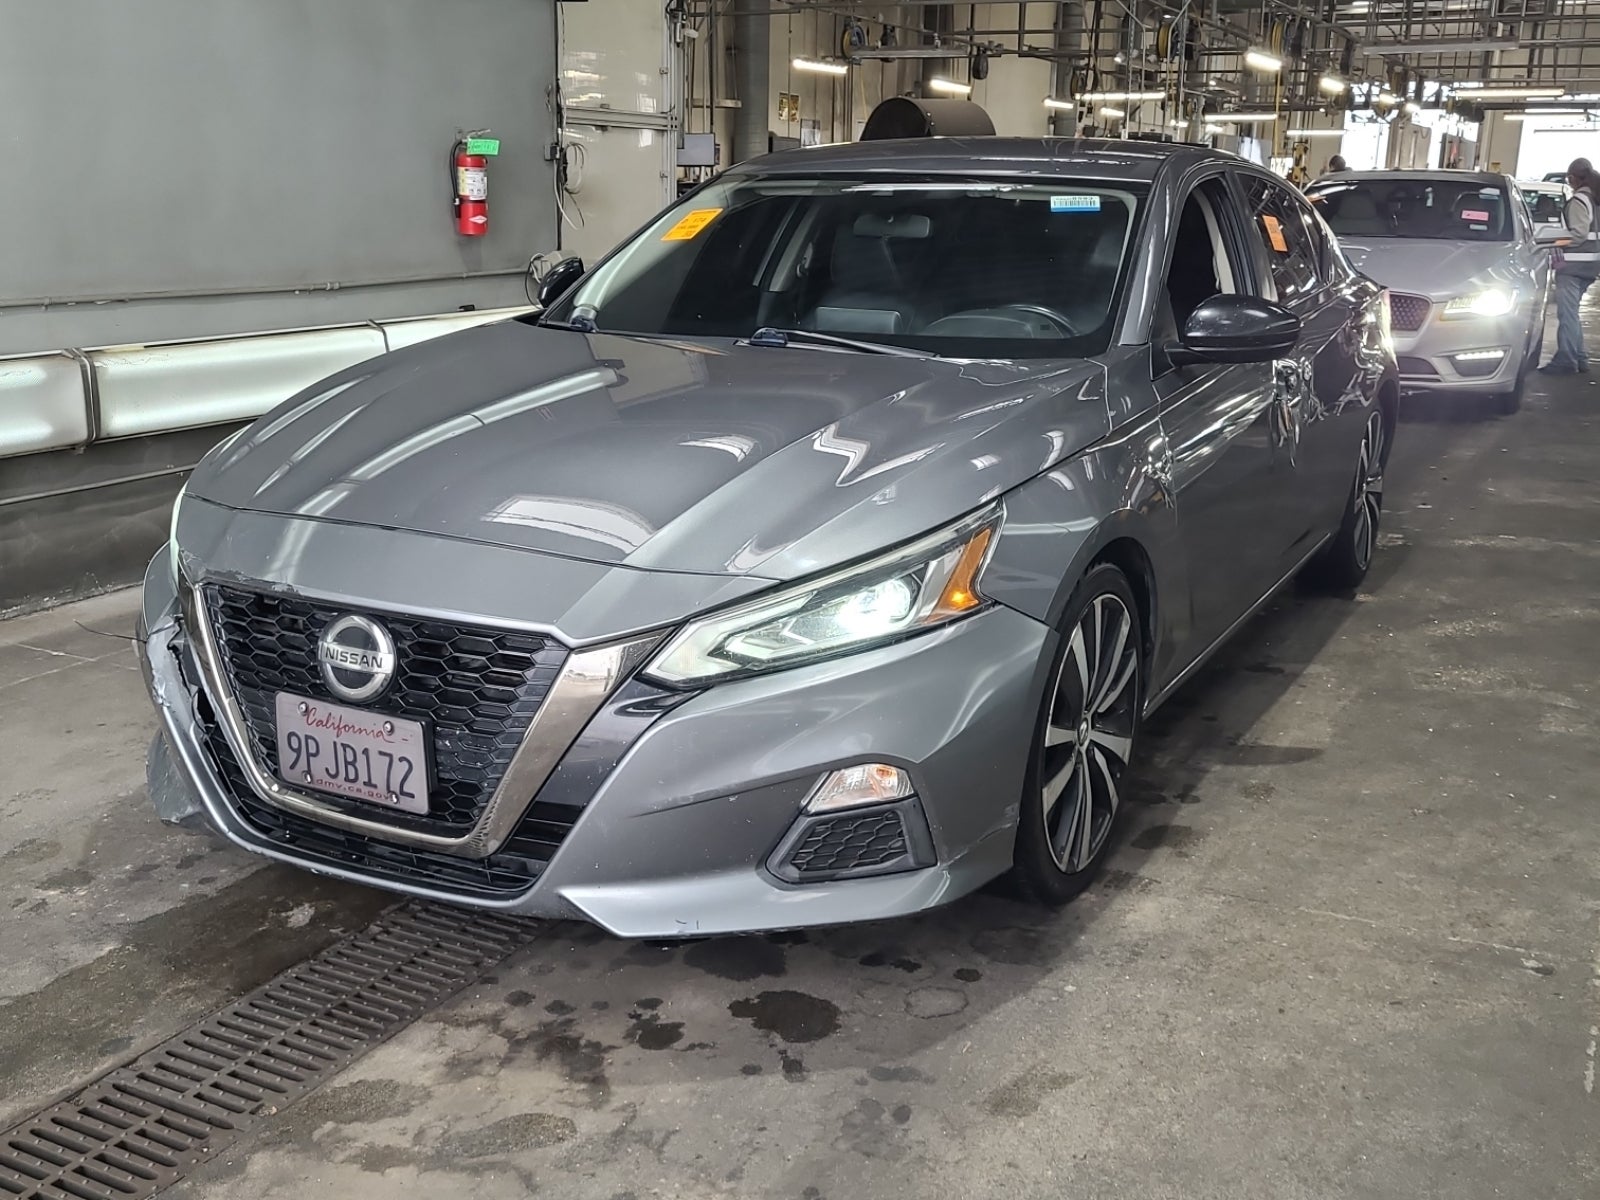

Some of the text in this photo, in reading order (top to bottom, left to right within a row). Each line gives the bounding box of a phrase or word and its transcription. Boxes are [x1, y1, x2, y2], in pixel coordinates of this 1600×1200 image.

[325, 646, 383, 669] NISSAN
[306, 707, 395, 744] California
[286, 731, 416, 799] 9PJB172
